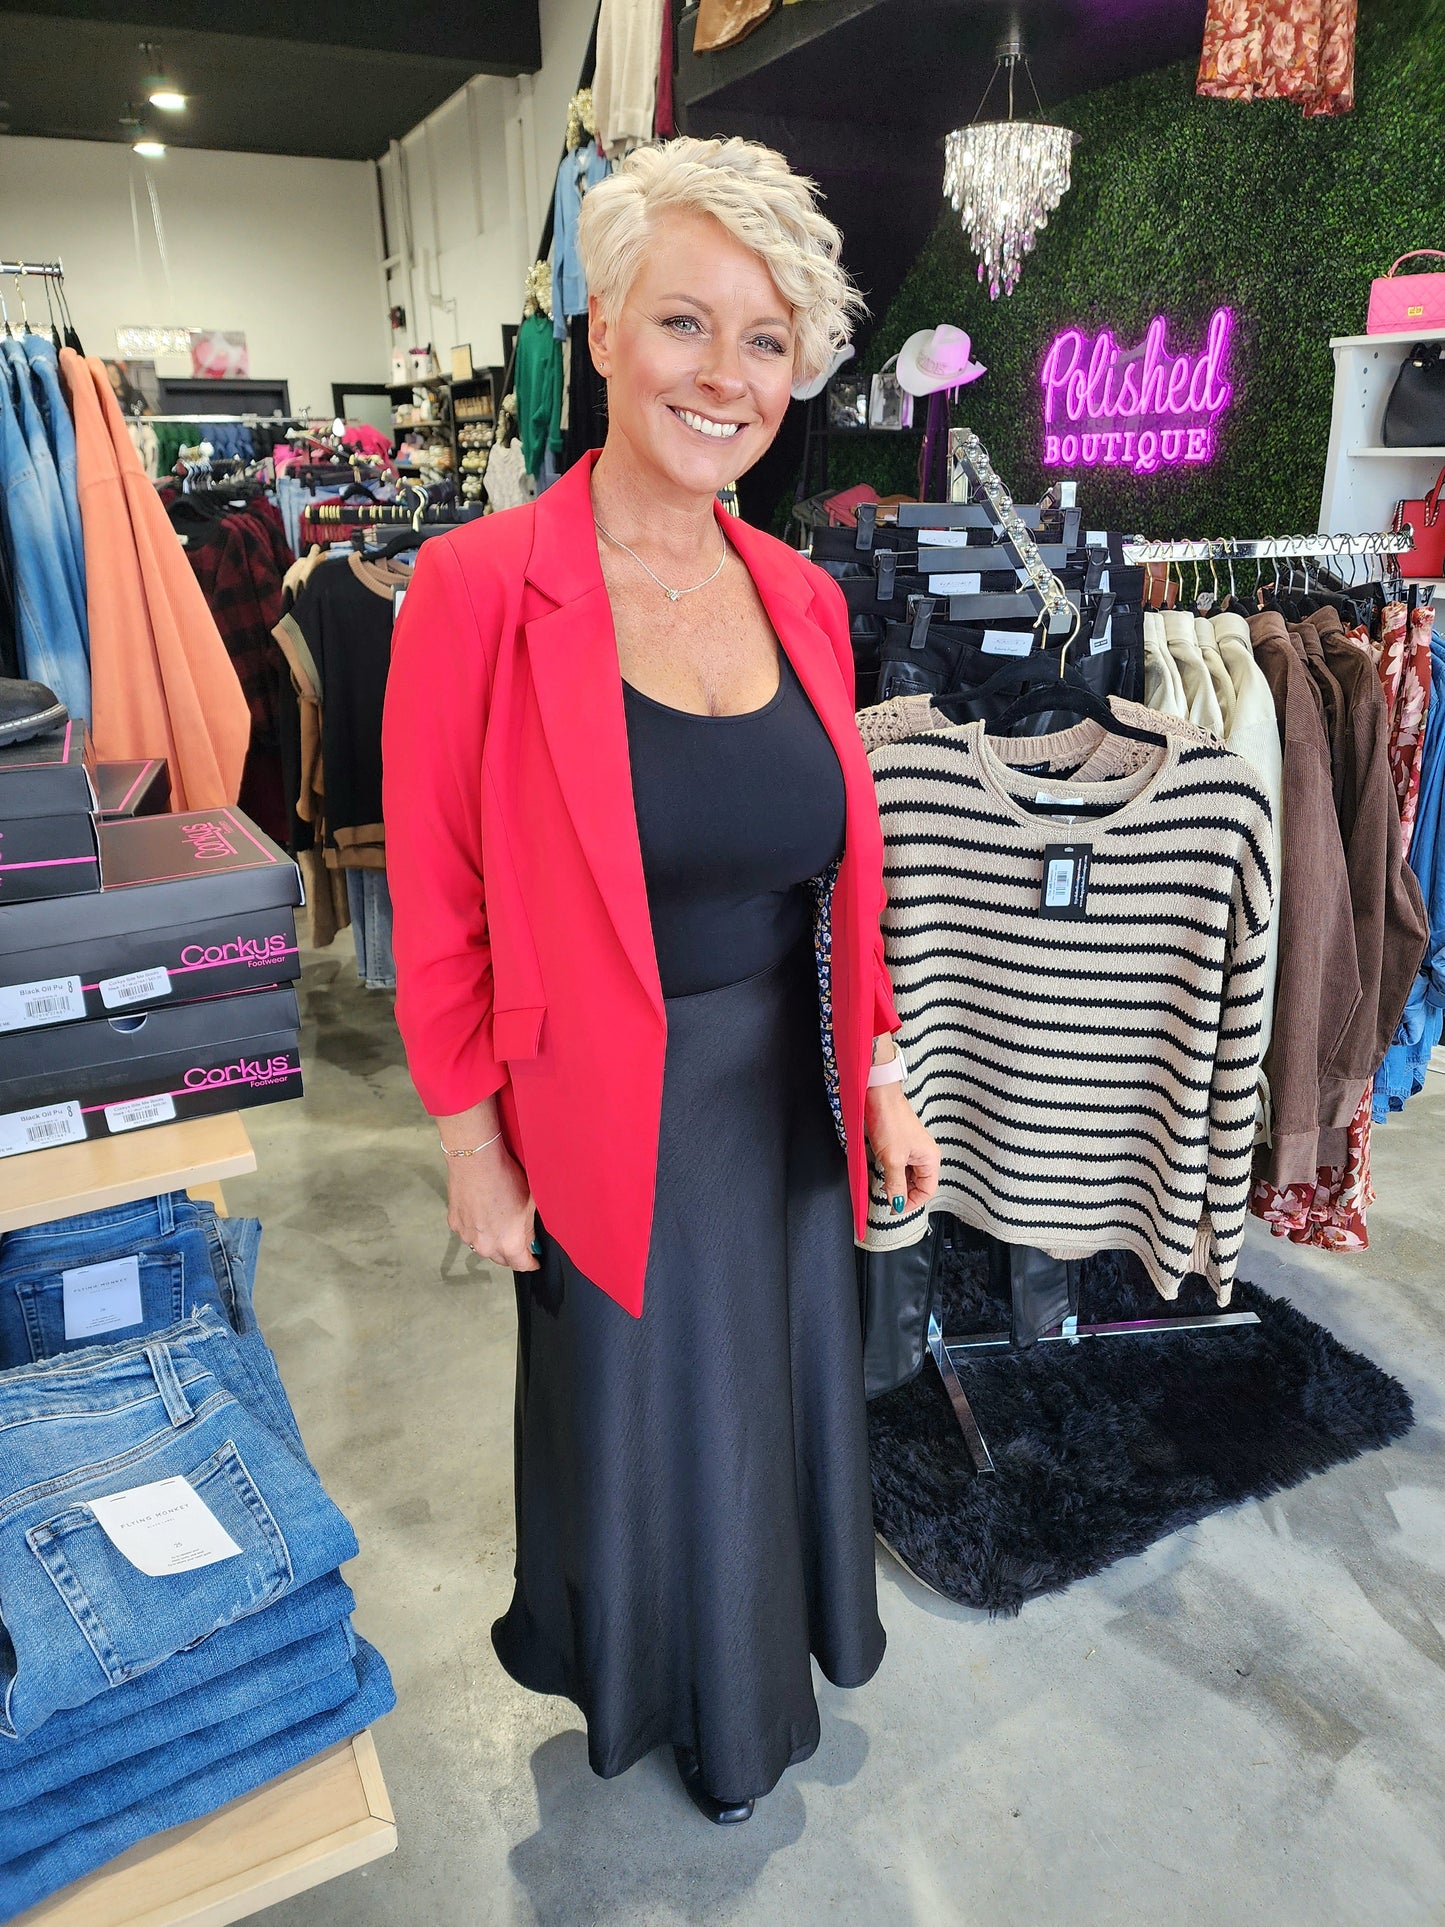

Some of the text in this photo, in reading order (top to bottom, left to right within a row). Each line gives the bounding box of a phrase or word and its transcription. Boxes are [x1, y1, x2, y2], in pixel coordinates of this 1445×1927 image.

[1041, 310, 1227, 423] Polished
[1043, 428, 1208, 470] BOUTIQUE
[180, 935, 286, 967] Corkys
[247, 956, 286, 968] Footwear
[19, 987, 40, 996] Black
[67, 980, 74, 994] 8
[183, 1055, 289, 1088] Corkys
[250, 1076, 288, 1088] Footwear
[20, 1113, 40, 1122] Black
[66, 1105, 73, 1118] 8
[120, 1503, 189, 1529] FLYING MONKEY
